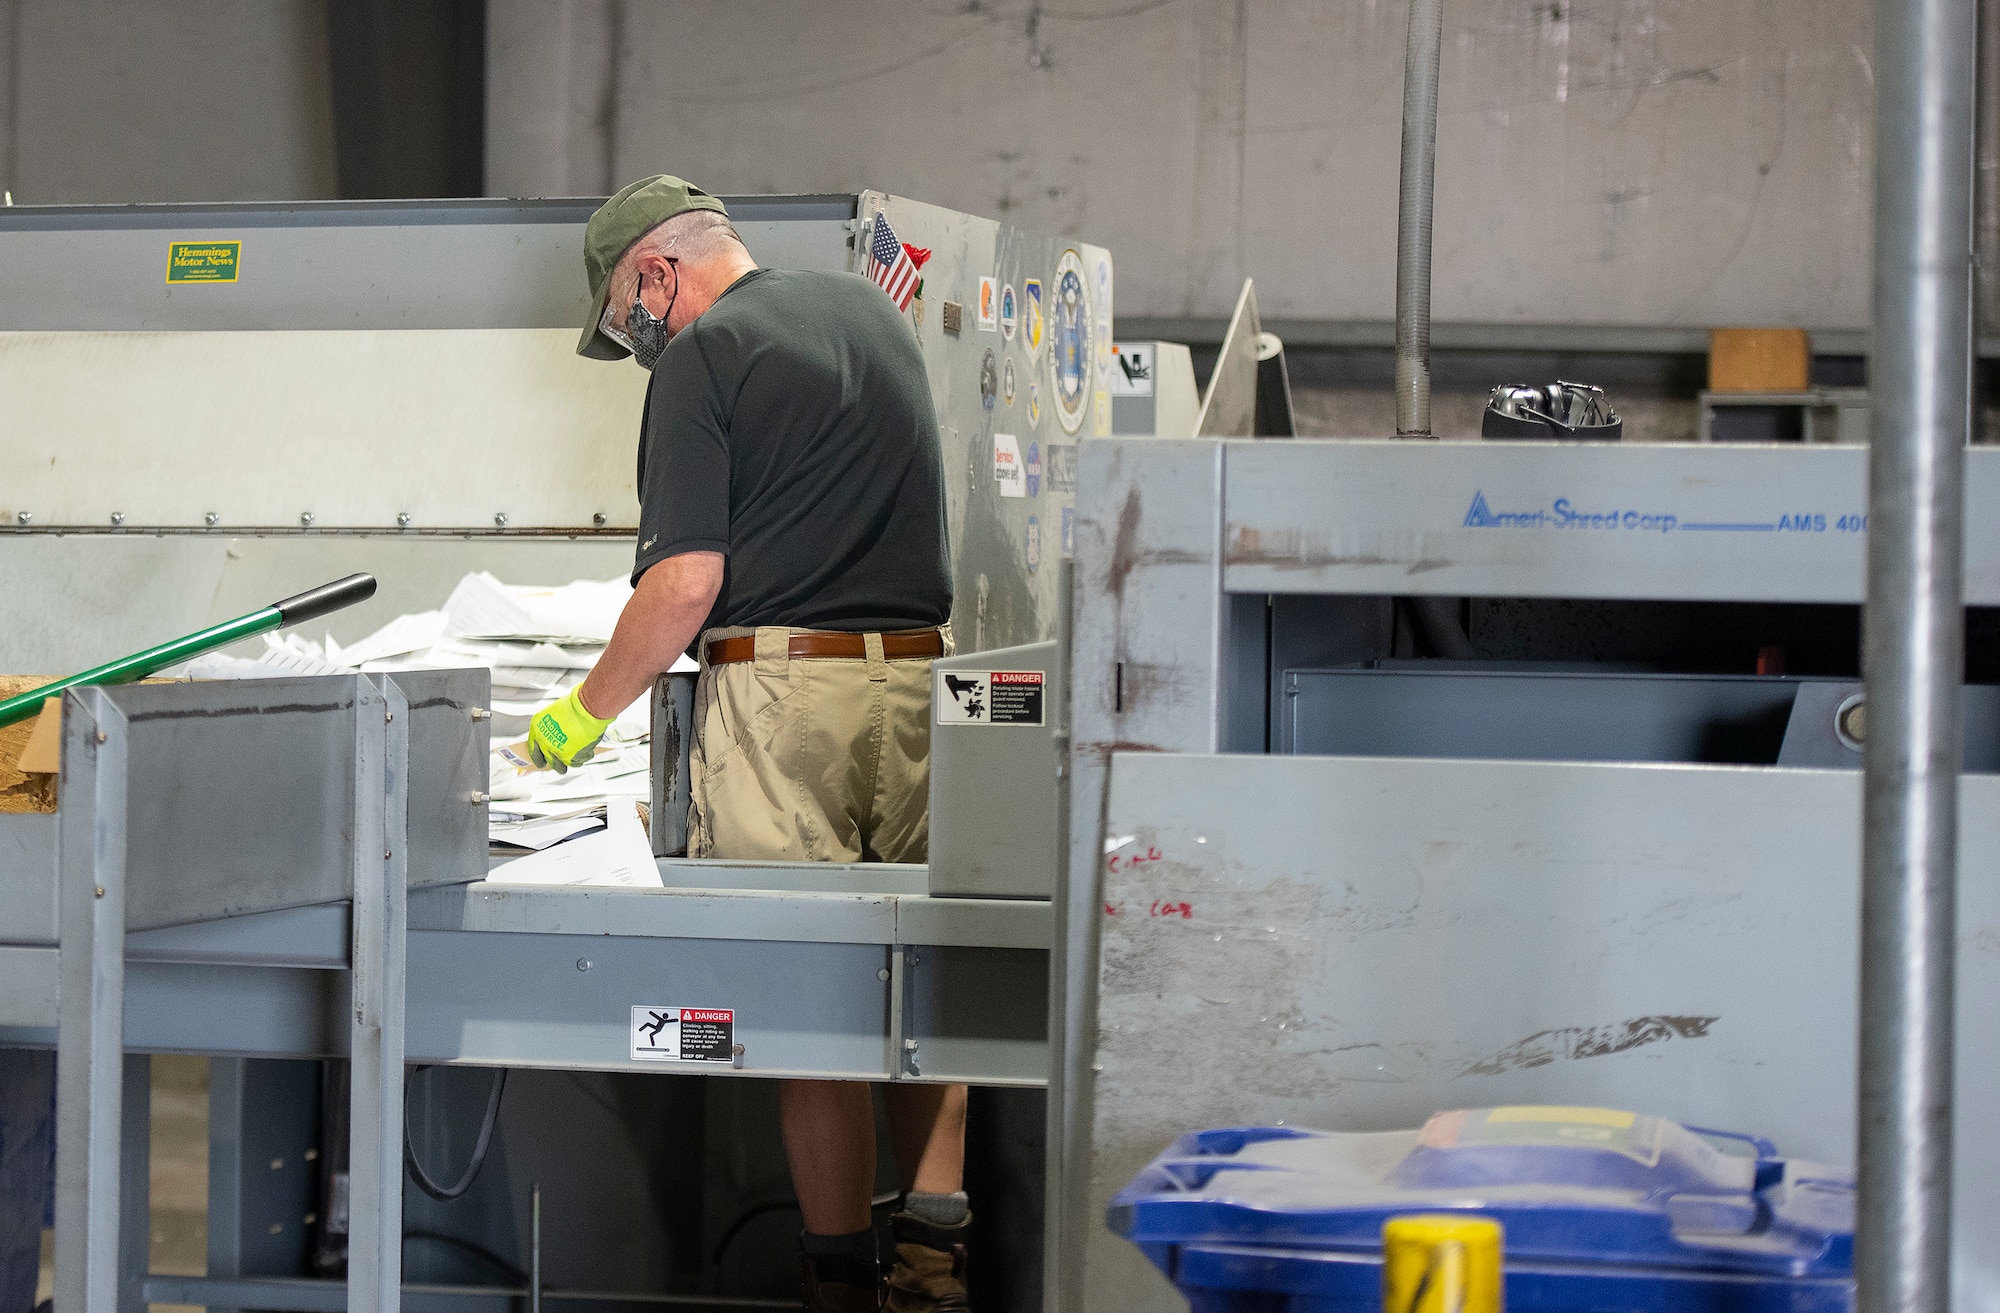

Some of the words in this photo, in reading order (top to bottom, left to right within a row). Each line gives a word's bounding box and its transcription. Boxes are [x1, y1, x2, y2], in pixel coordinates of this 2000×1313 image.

[178, 247, 232, 258] Hemmings
[174, 257, 205, 267] Motor
[206, 256, 234, 266] News
[996, 448, 1014, 463] Service
[996, 467, 1010, 480] above
[1777, 513, 1826, 532] AMS
[1002, 674, 1041, 682] DANGER
[537, 720, 563, 750] SOURCE
[544, 717, 567, 741] PROJECT
[695, 1012, 730, 1020] DANGER
